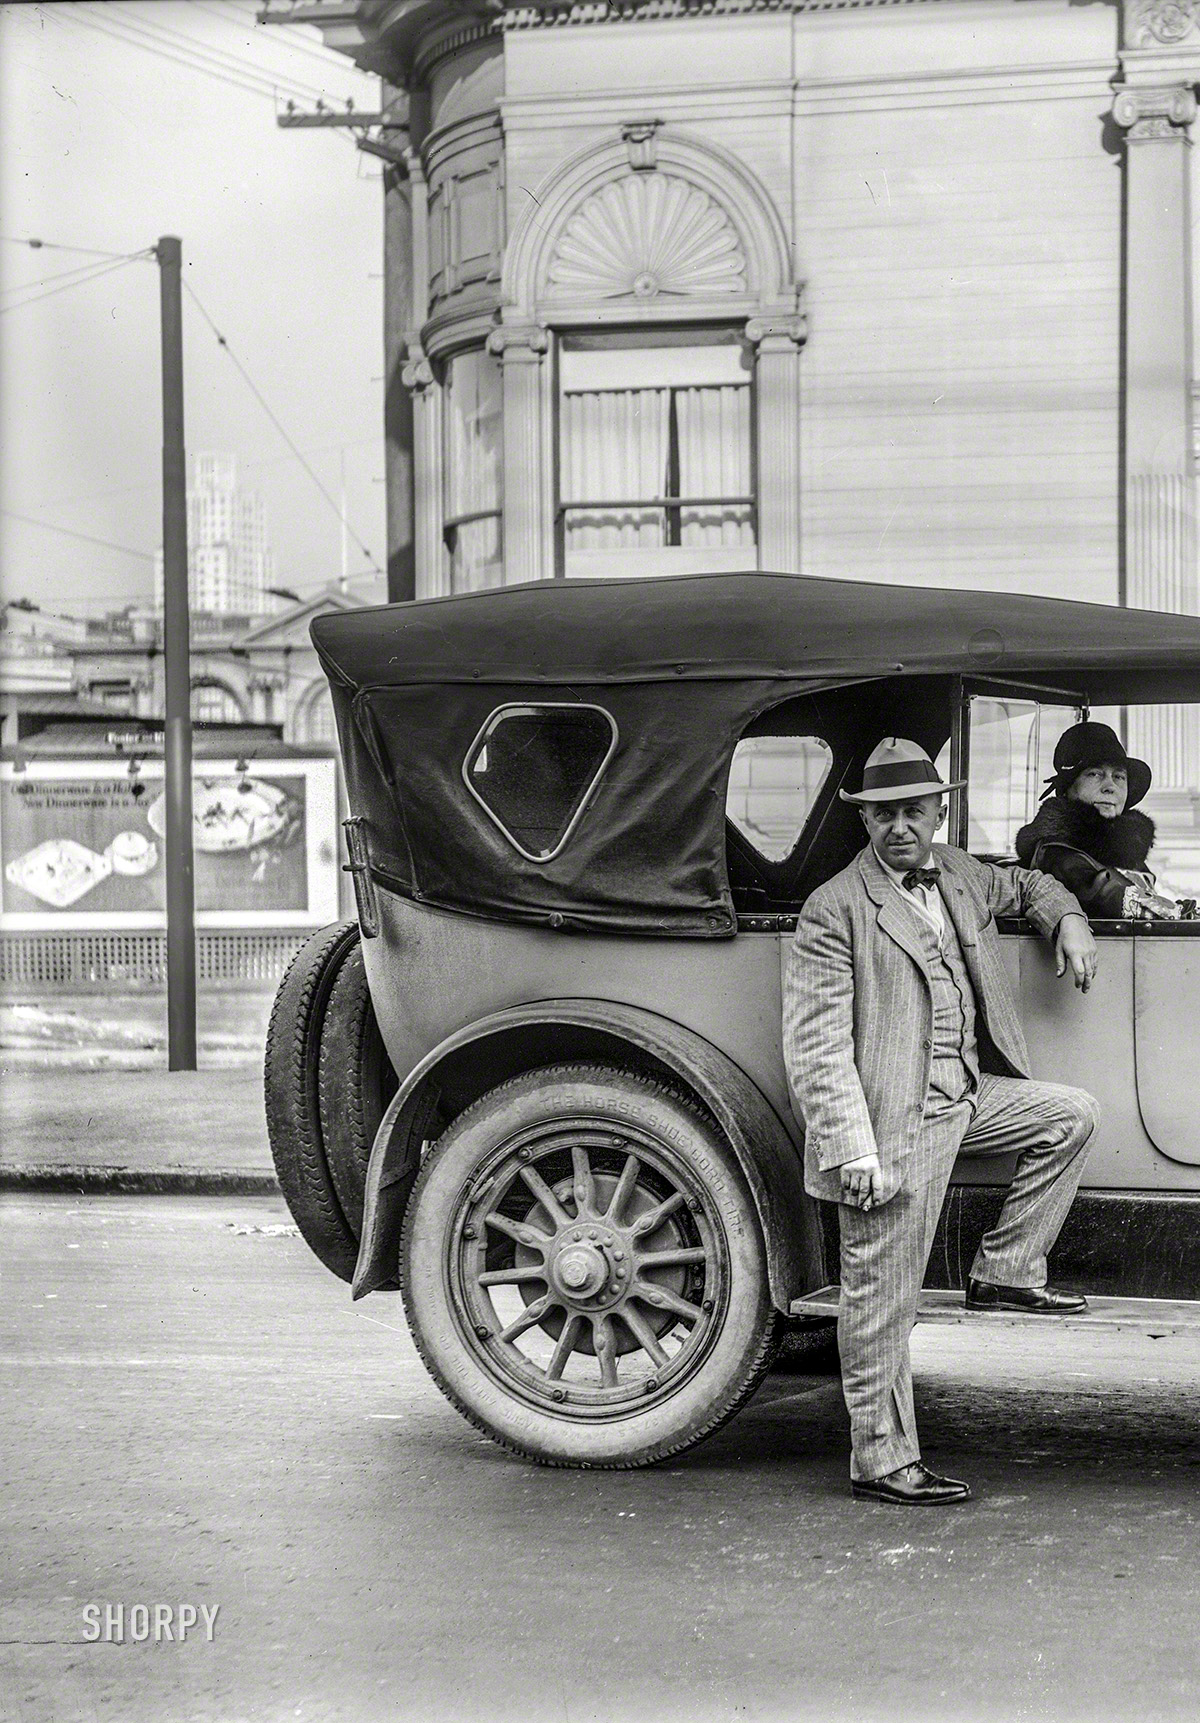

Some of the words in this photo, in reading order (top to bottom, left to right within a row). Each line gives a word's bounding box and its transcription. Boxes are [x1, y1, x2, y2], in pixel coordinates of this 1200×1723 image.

[46, 797, 107, 808] Dinnerware
[540, 1095, 575, 1112] THE
[583, 1096, 642, 1119] HORSE
[647, 1113, 689, 1148] SHOE
